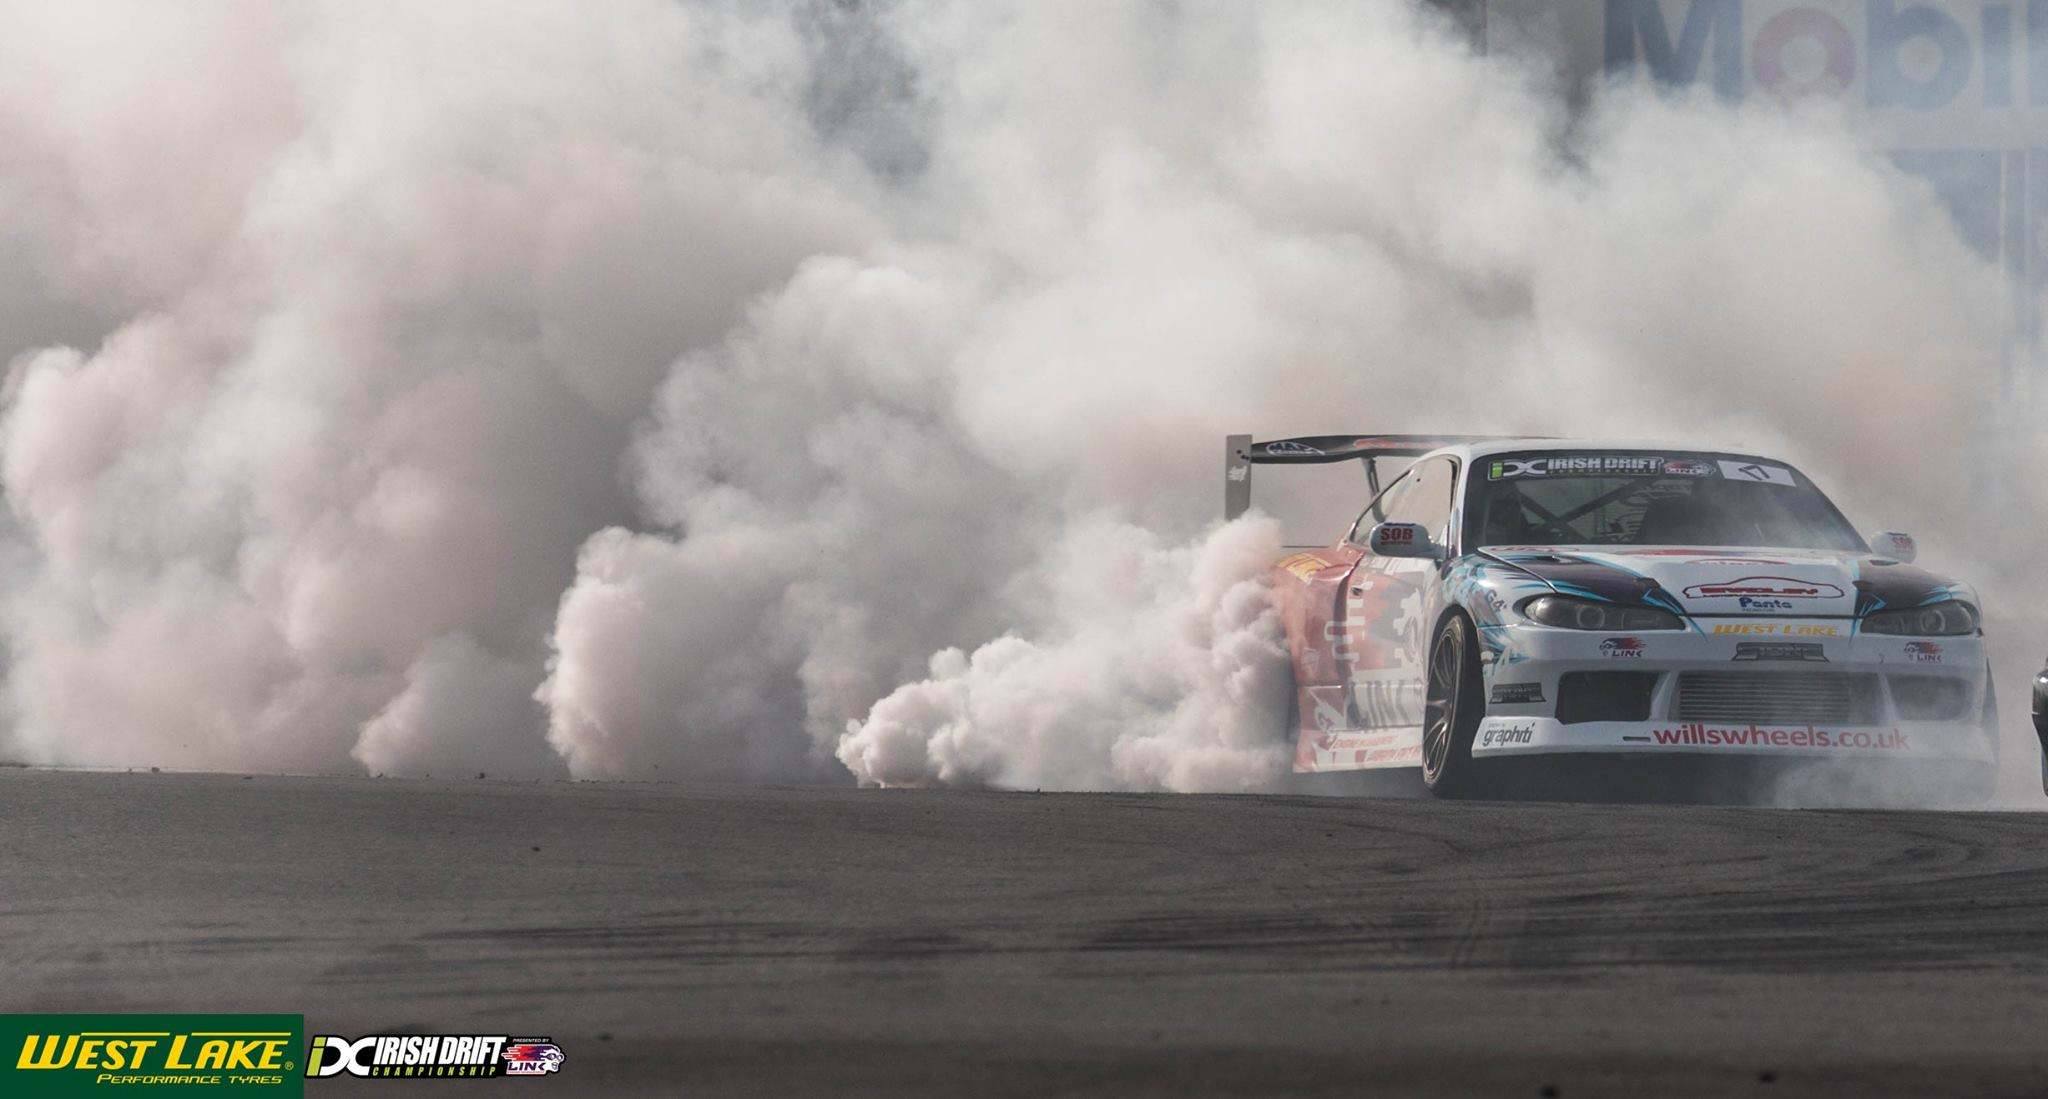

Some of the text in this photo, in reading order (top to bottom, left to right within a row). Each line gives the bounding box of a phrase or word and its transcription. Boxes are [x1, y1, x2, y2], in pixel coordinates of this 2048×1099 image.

[1548, 458, 1601, 470] IRISH
[1604, 457, 1656, 469] DRIFT
[1713, 624, 1840, 636] WEST LAKE
[1653, 723, 1910, 749] willswheels.co.uk
